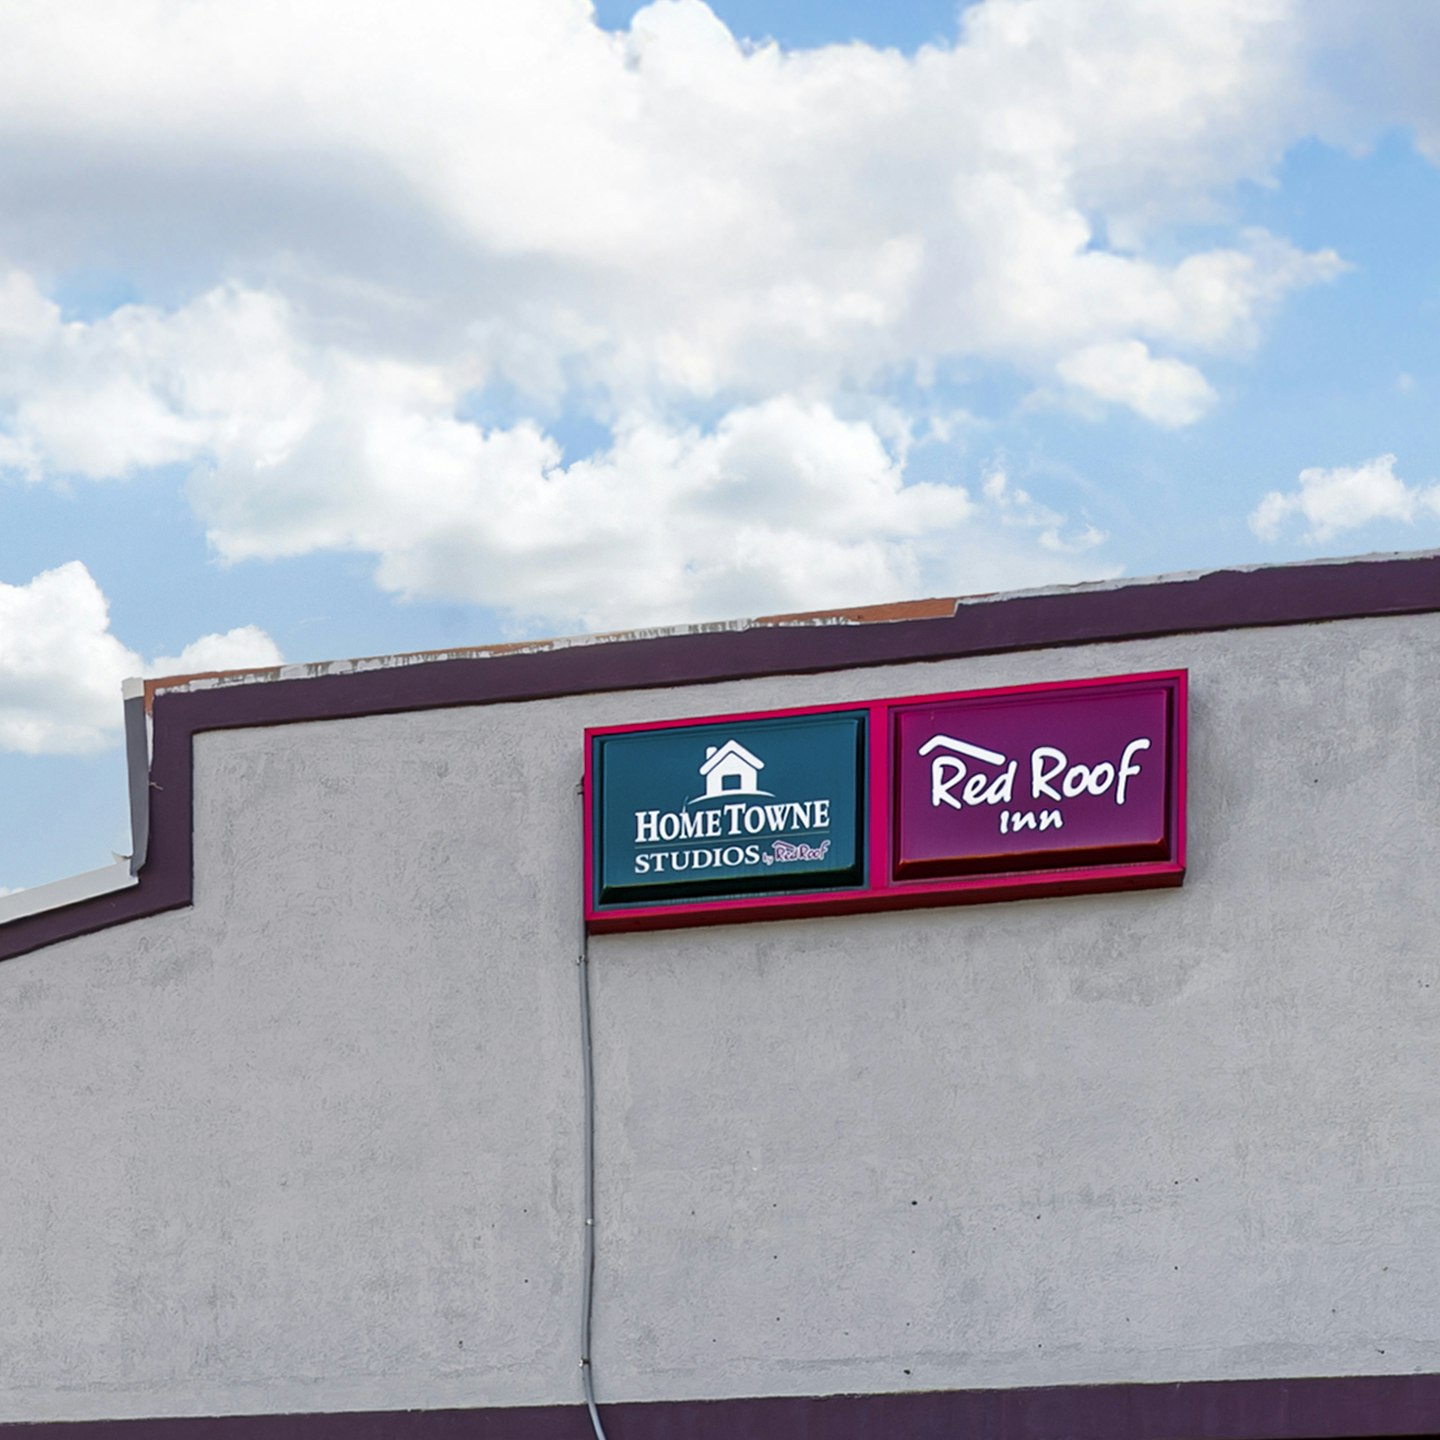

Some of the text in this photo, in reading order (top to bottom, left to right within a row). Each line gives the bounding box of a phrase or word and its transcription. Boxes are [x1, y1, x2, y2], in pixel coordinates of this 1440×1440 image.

[931, 738, 1151, 810] Red Roof
[634, 844, 761, 874] STUDIOS
